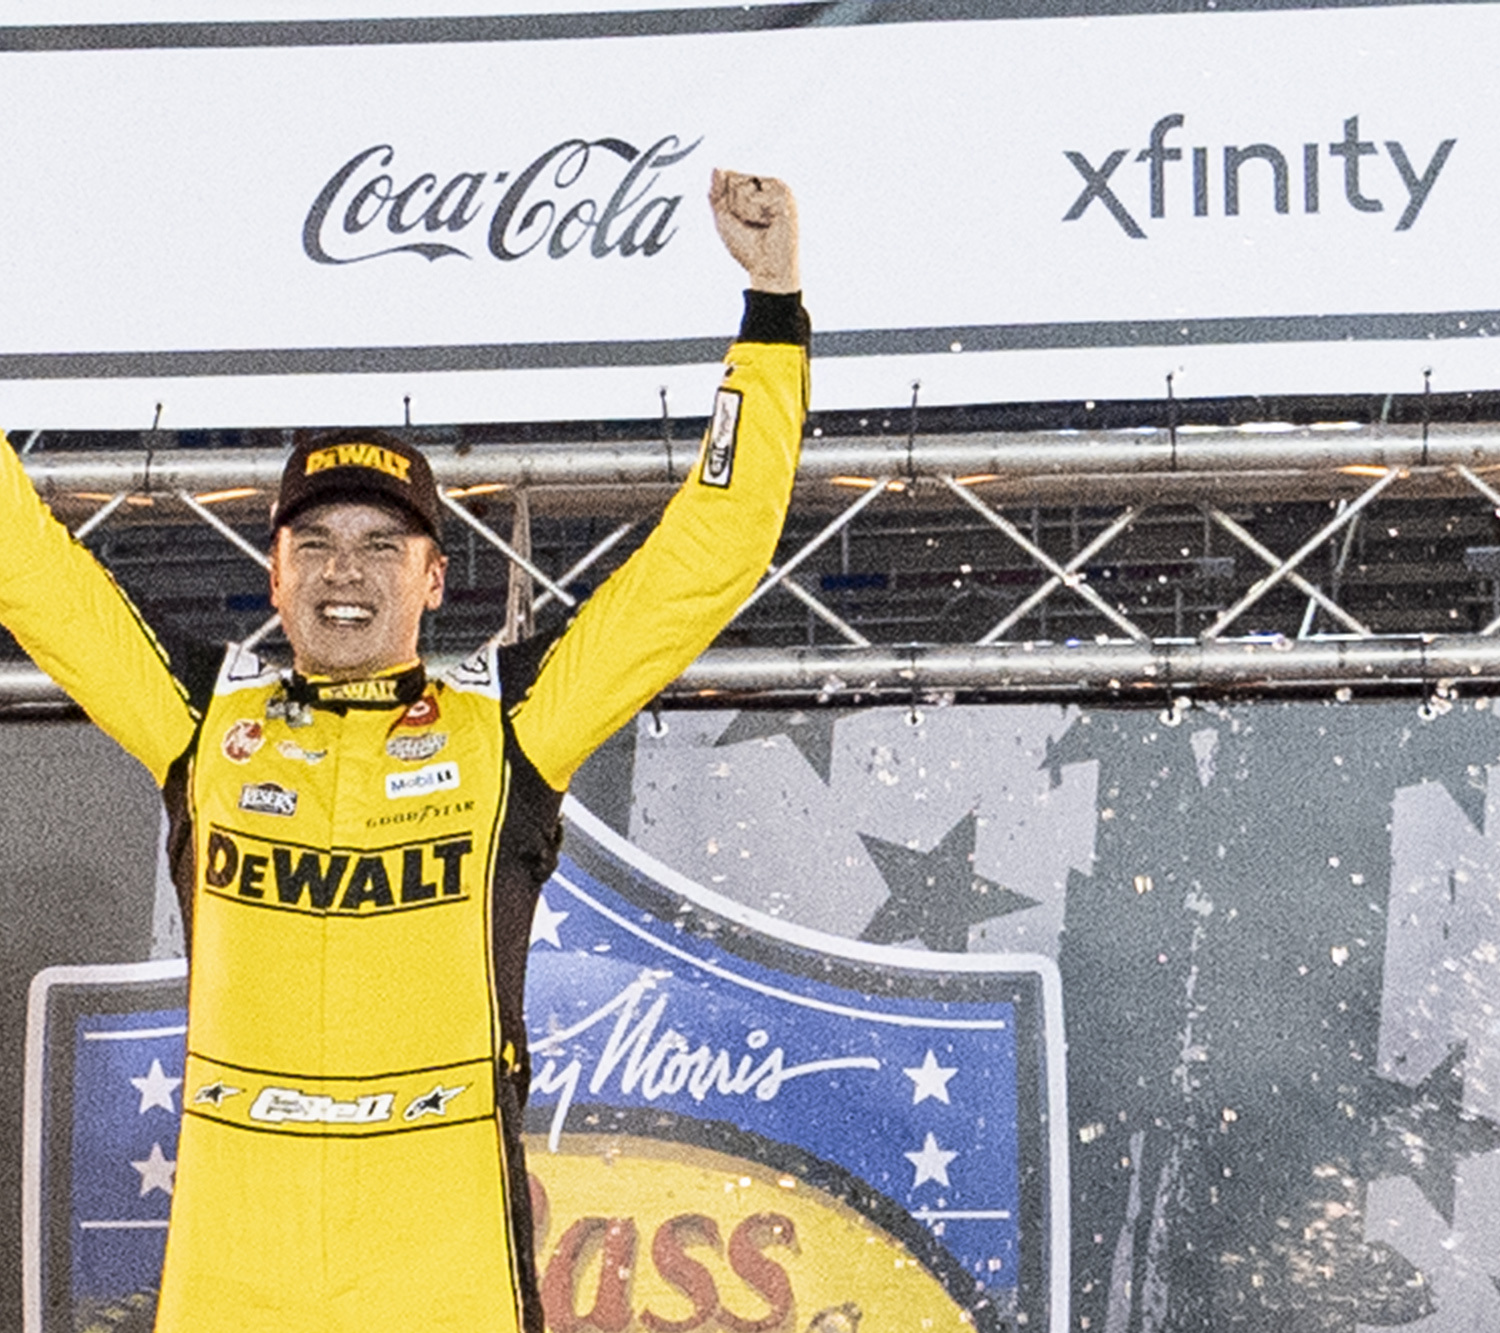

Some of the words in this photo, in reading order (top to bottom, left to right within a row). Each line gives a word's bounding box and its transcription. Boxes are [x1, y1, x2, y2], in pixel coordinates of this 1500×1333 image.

[302, 132, 706, 267] Coca-Cola
[1061, 113, 1458, 239] xfinity
[205, 836, 474, 912] DEWALT
